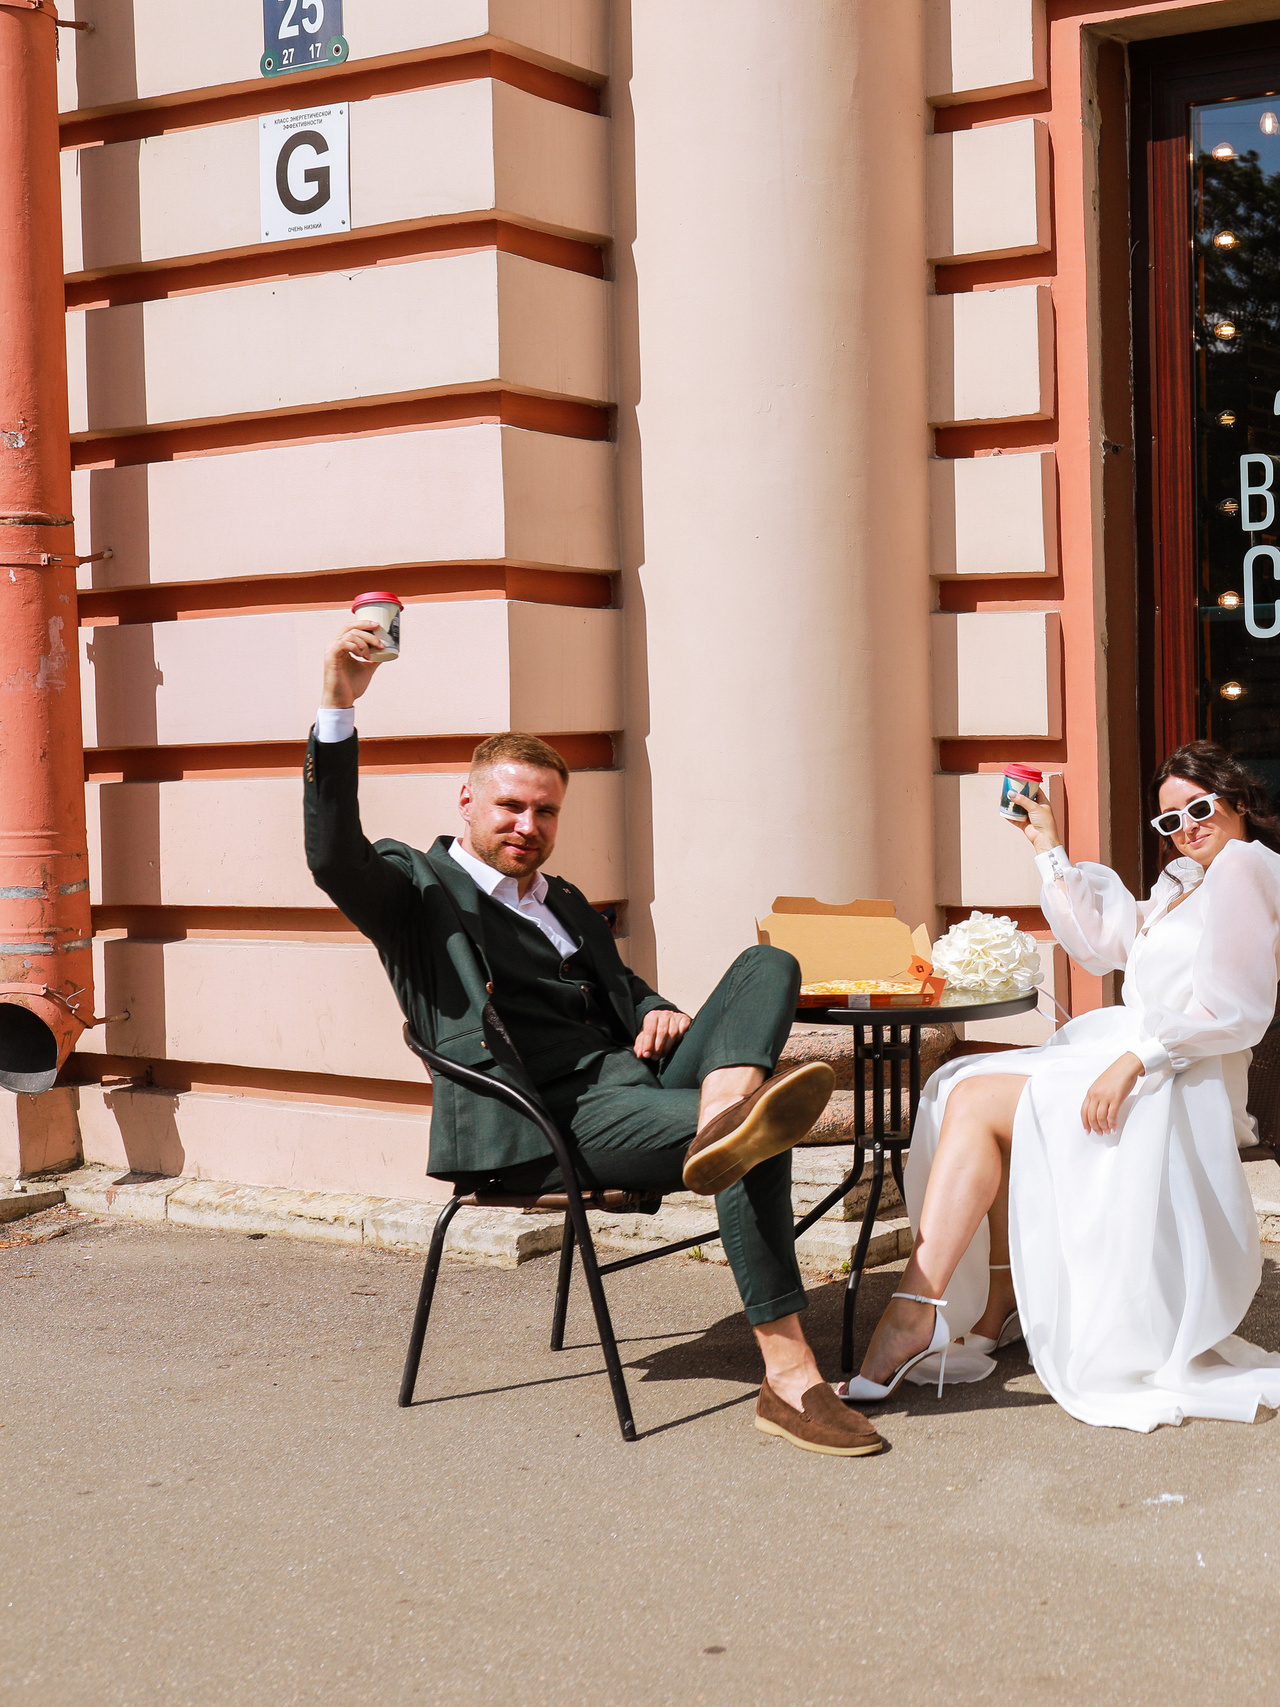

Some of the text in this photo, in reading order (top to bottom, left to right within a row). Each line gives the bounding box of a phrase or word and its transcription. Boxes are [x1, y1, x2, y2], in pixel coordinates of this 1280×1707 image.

[278, 0, 324, 39] 25
[282, 48, 295, 65] 27
[309, 42, 322, 59] 17
[274, 109, 332, 125] КЛАСС ЭНЕРГЕТИЧЕСКОЙ
[283, 118, 323, 130] ЭФФЕКТИВНОСТИ
[276, 130, 331, 215] G
[304, 222, 322, 230] НИЗКИЙ
